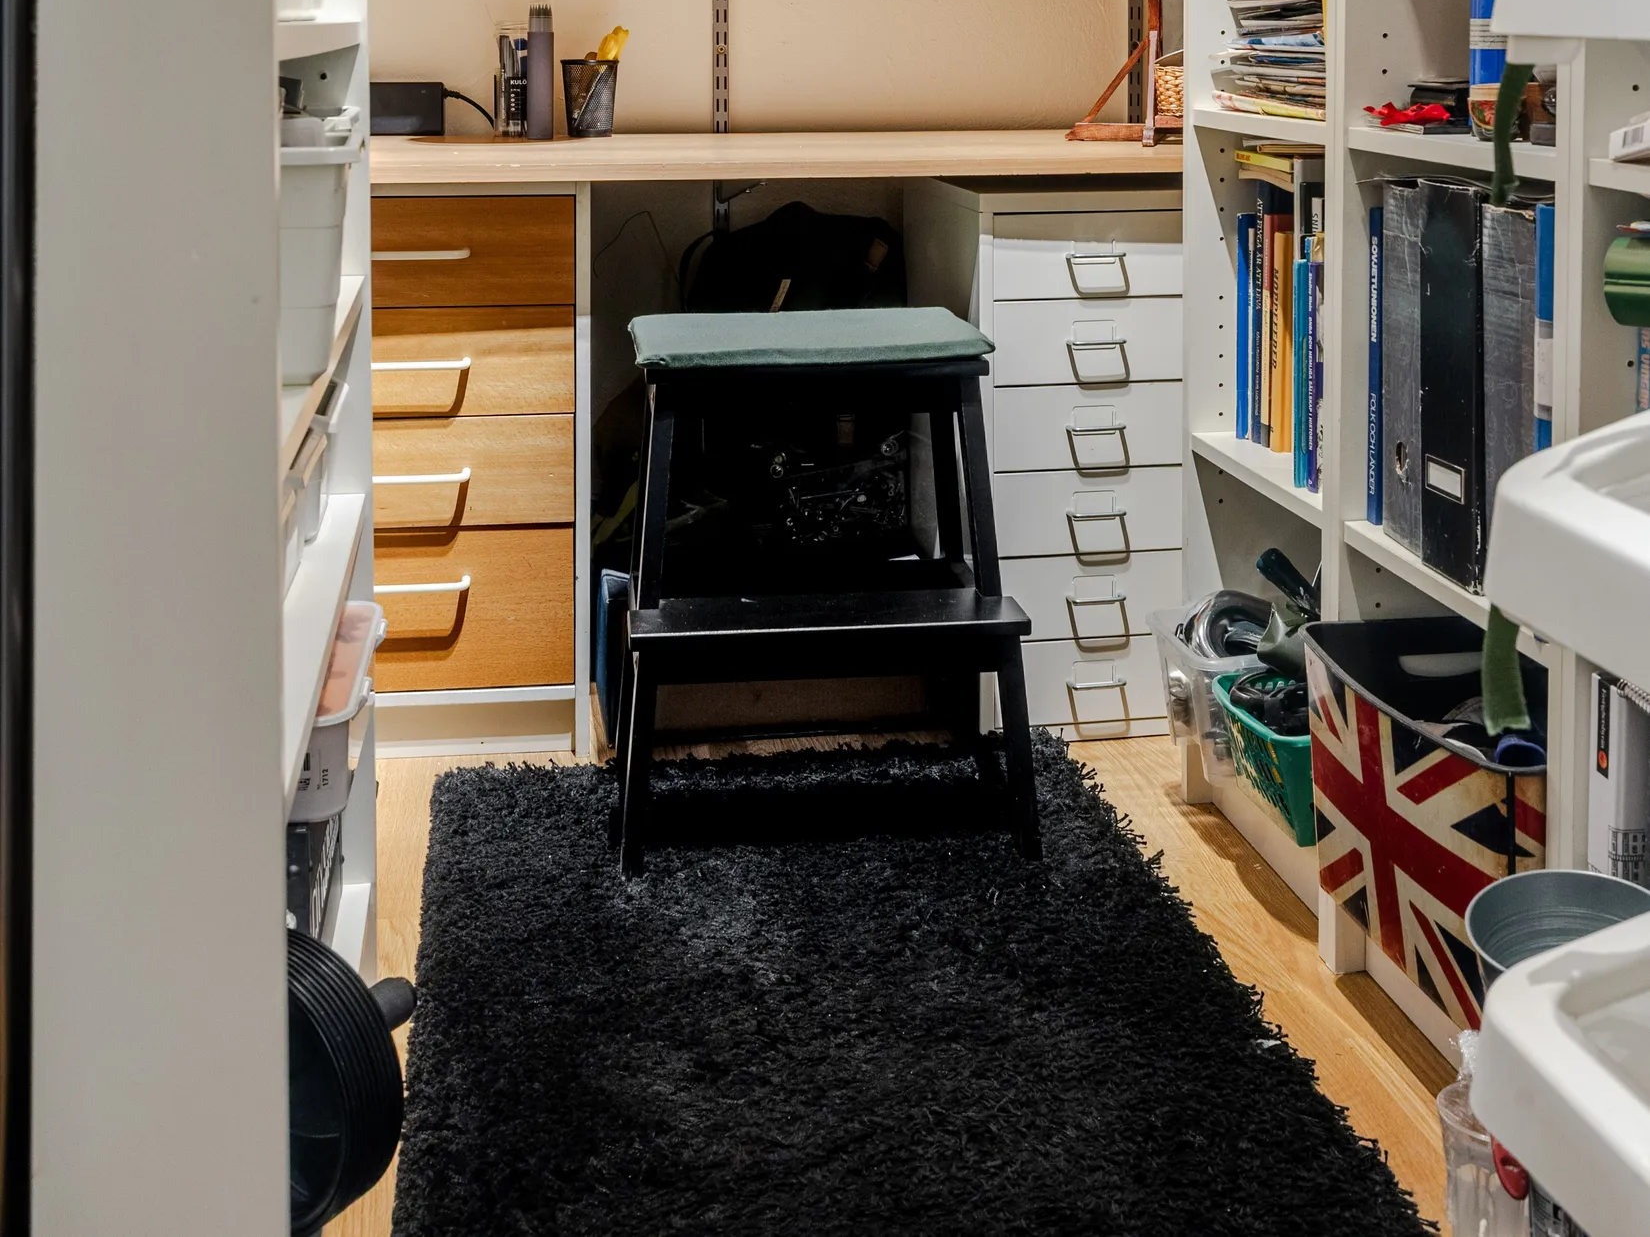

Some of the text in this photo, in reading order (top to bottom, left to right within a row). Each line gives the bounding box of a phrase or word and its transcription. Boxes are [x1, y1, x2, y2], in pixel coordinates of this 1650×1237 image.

[1255, 198, 1264, 310] ATT FLYGA ÄR ATT LEVA
